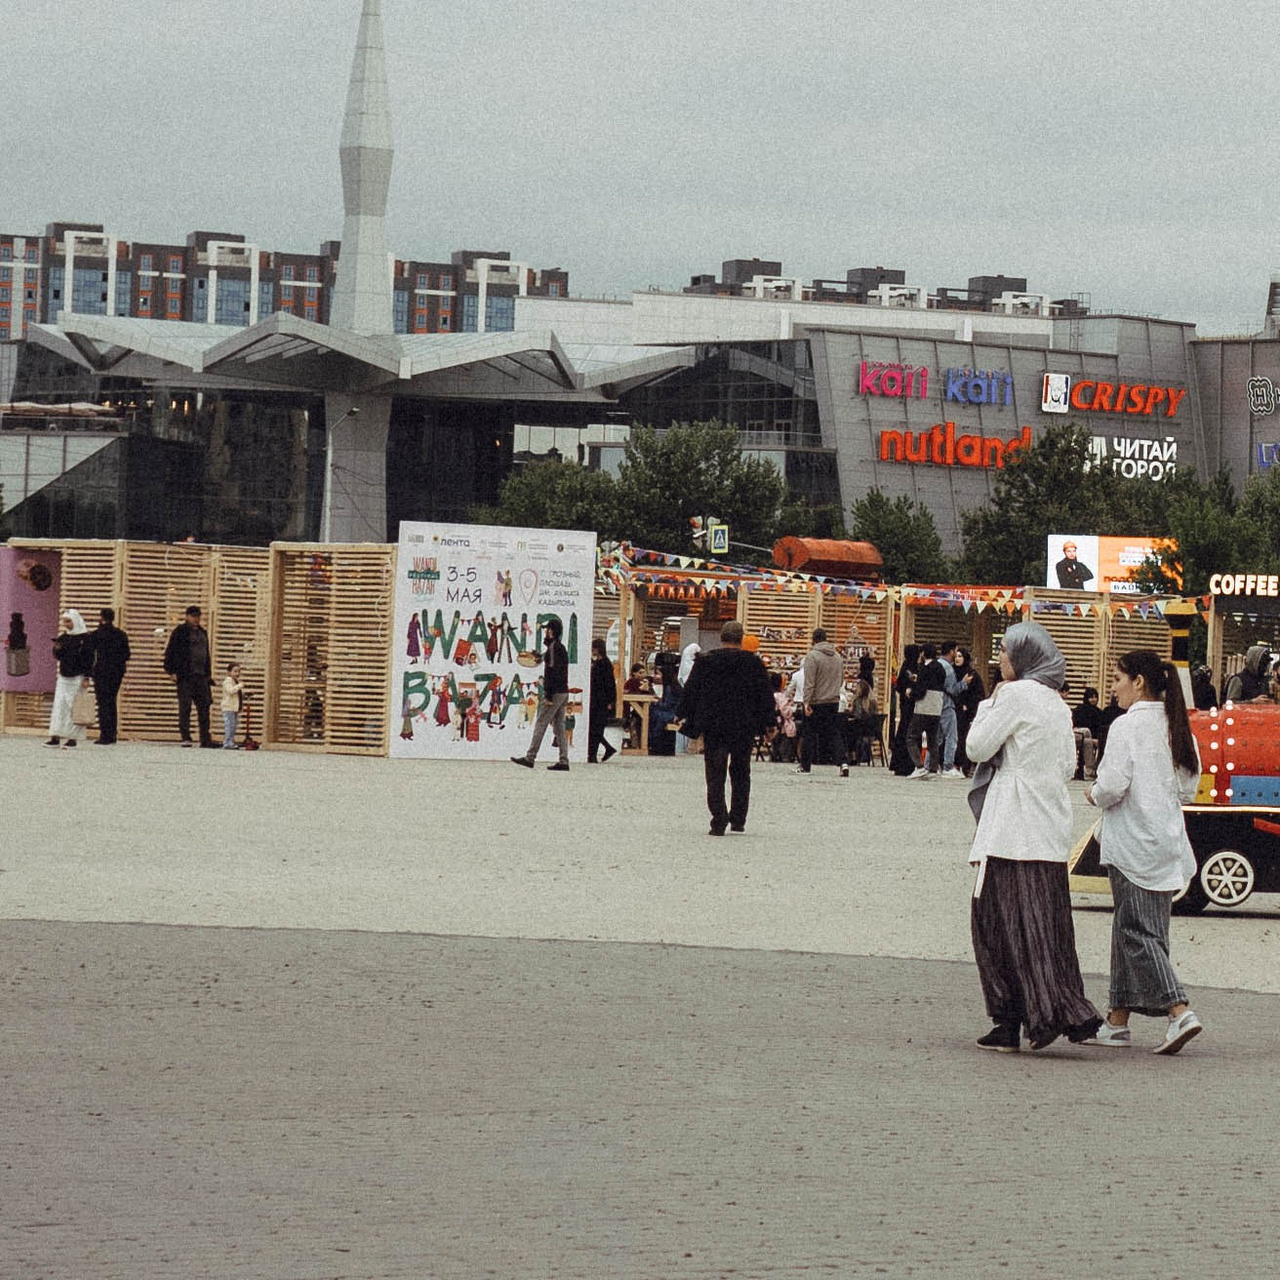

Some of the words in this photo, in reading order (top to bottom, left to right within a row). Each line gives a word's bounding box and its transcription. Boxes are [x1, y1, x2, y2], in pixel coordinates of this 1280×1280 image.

[859, 359, 929, 400] kari
[945, 366, 1014, 407] kari
[1070, 379, 1187, 418] CRISPY
[879, 422, 1033, 469] nutland
[1113, 436, 1178, 462] ЧИТАЙ
[440, 538, 471, 547] лента
[447, 566, 477, 583] 3-5
[1209, 573, 1279, 597] COFFEE
[446, 587, 482, 604] МАЯ
